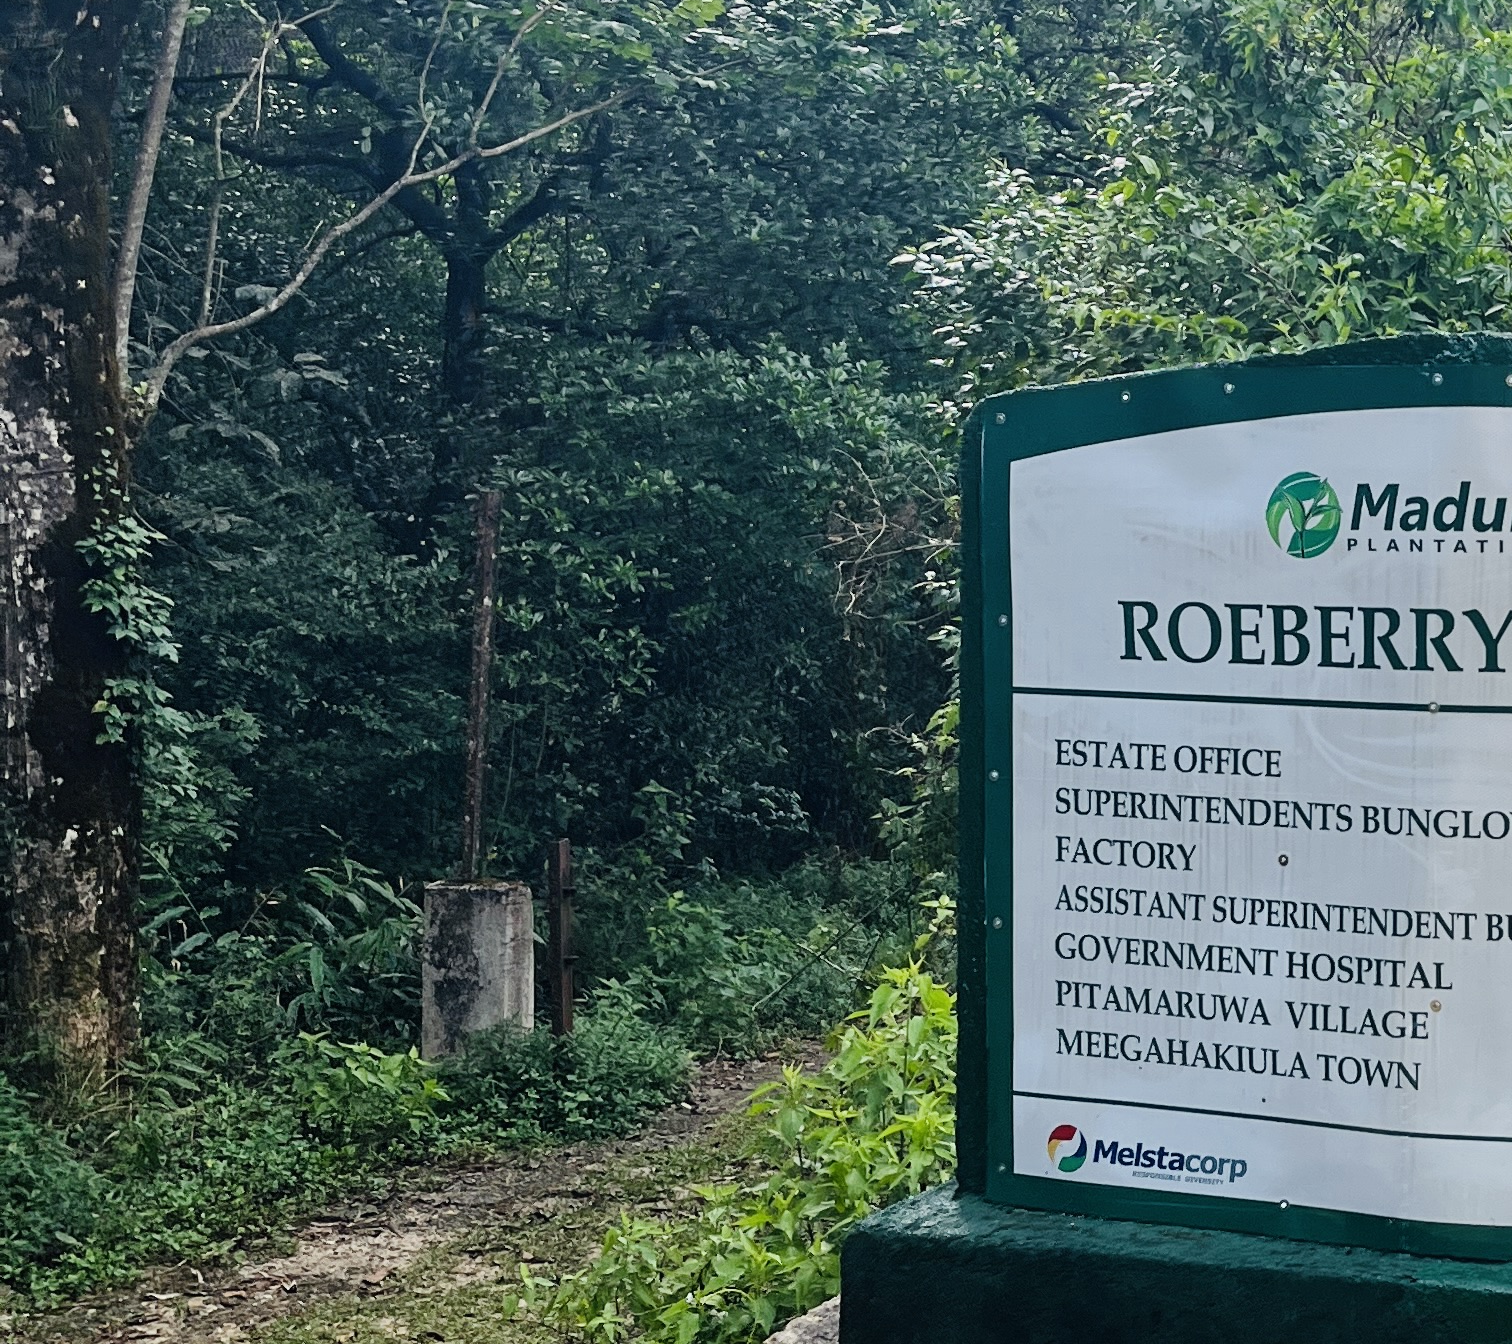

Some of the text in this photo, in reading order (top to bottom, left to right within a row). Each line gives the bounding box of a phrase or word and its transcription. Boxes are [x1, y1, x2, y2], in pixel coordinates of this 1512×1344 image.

[1054, 738, 1282, 778] ESTATE OFFICE
[1054, 787, 1353, 833] SUPERINTENDENTS
[1054, 835, 1197, 872] FACTORY
[1054, 884, 1206, 922] ASSISTANT
[1212, 895, 1478, 941] SUPERINTENDENT
[1054, 932, 1453, 990] GOVERNMENT HOSPITAL
[1054, 979, 1429, 1040] PITAMARUWA VILLAGE
[1055, 1028, 1422, 1091] MEEGAHAKIULA TOWN
[1092, 1139, 1248, 1183] Melstacorp
